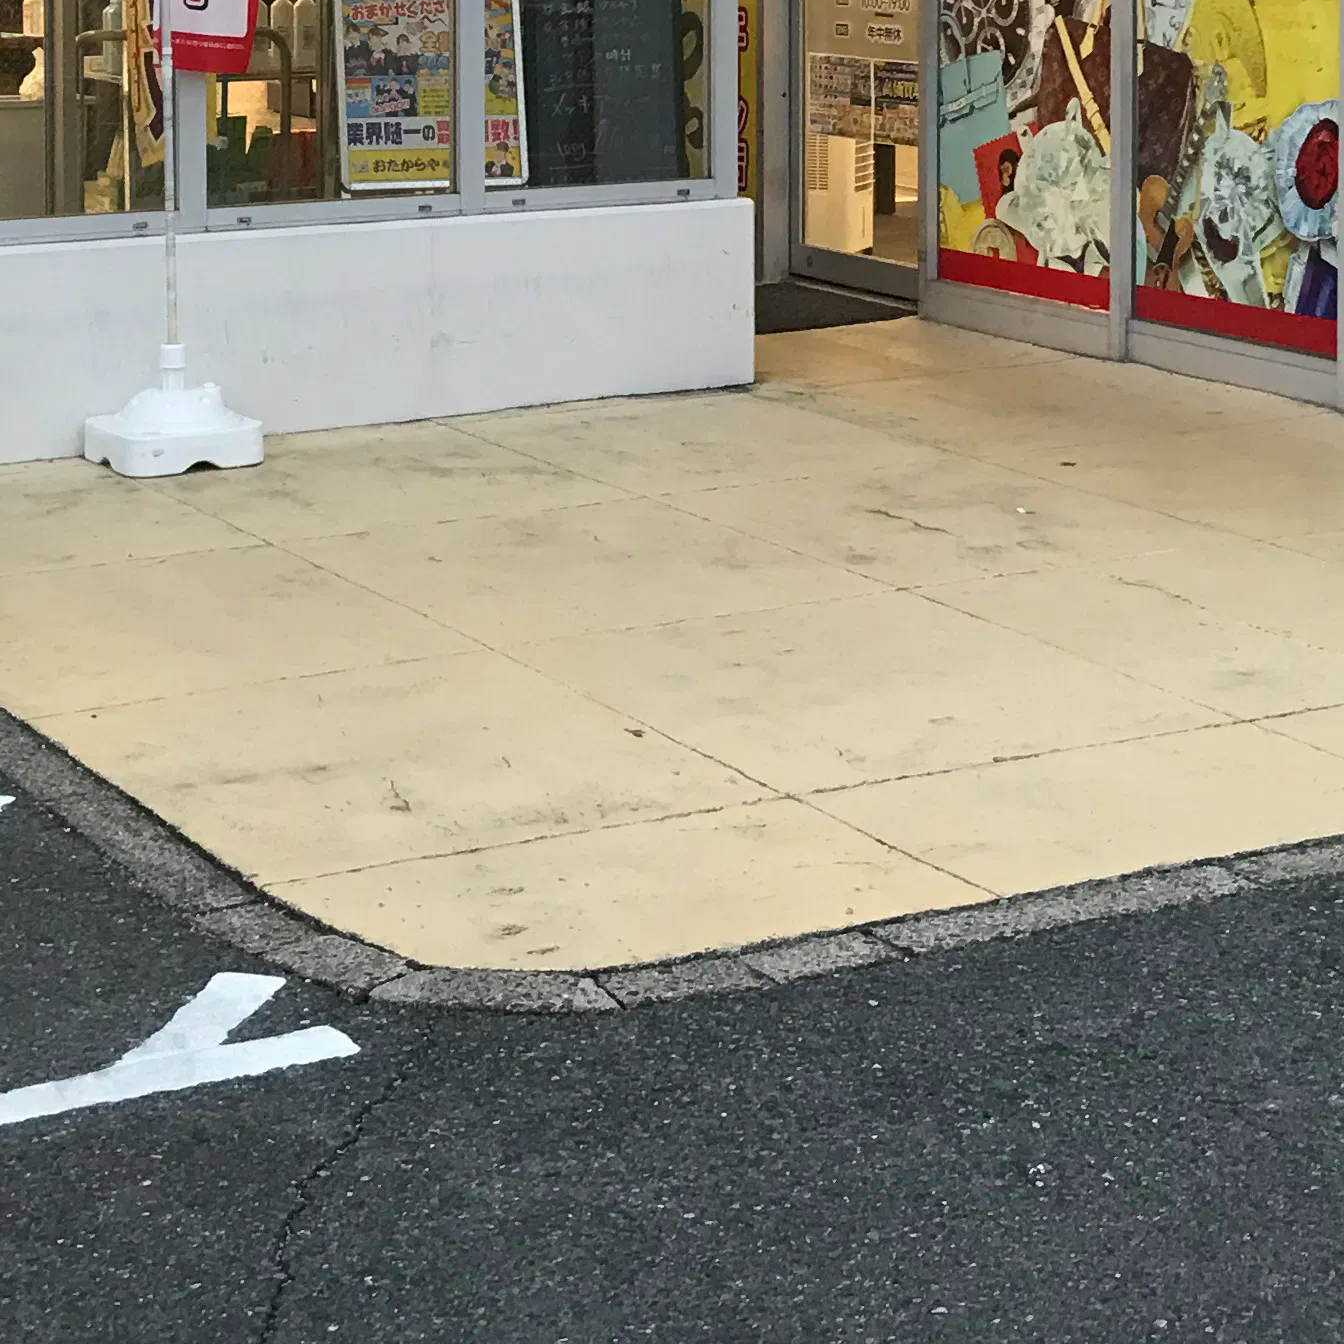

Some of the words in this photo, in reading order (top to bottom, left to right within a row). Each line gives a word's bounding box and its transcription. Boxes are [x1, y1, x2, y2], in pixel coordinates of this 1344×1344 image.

[373, 159, 440, 173] おたからや
